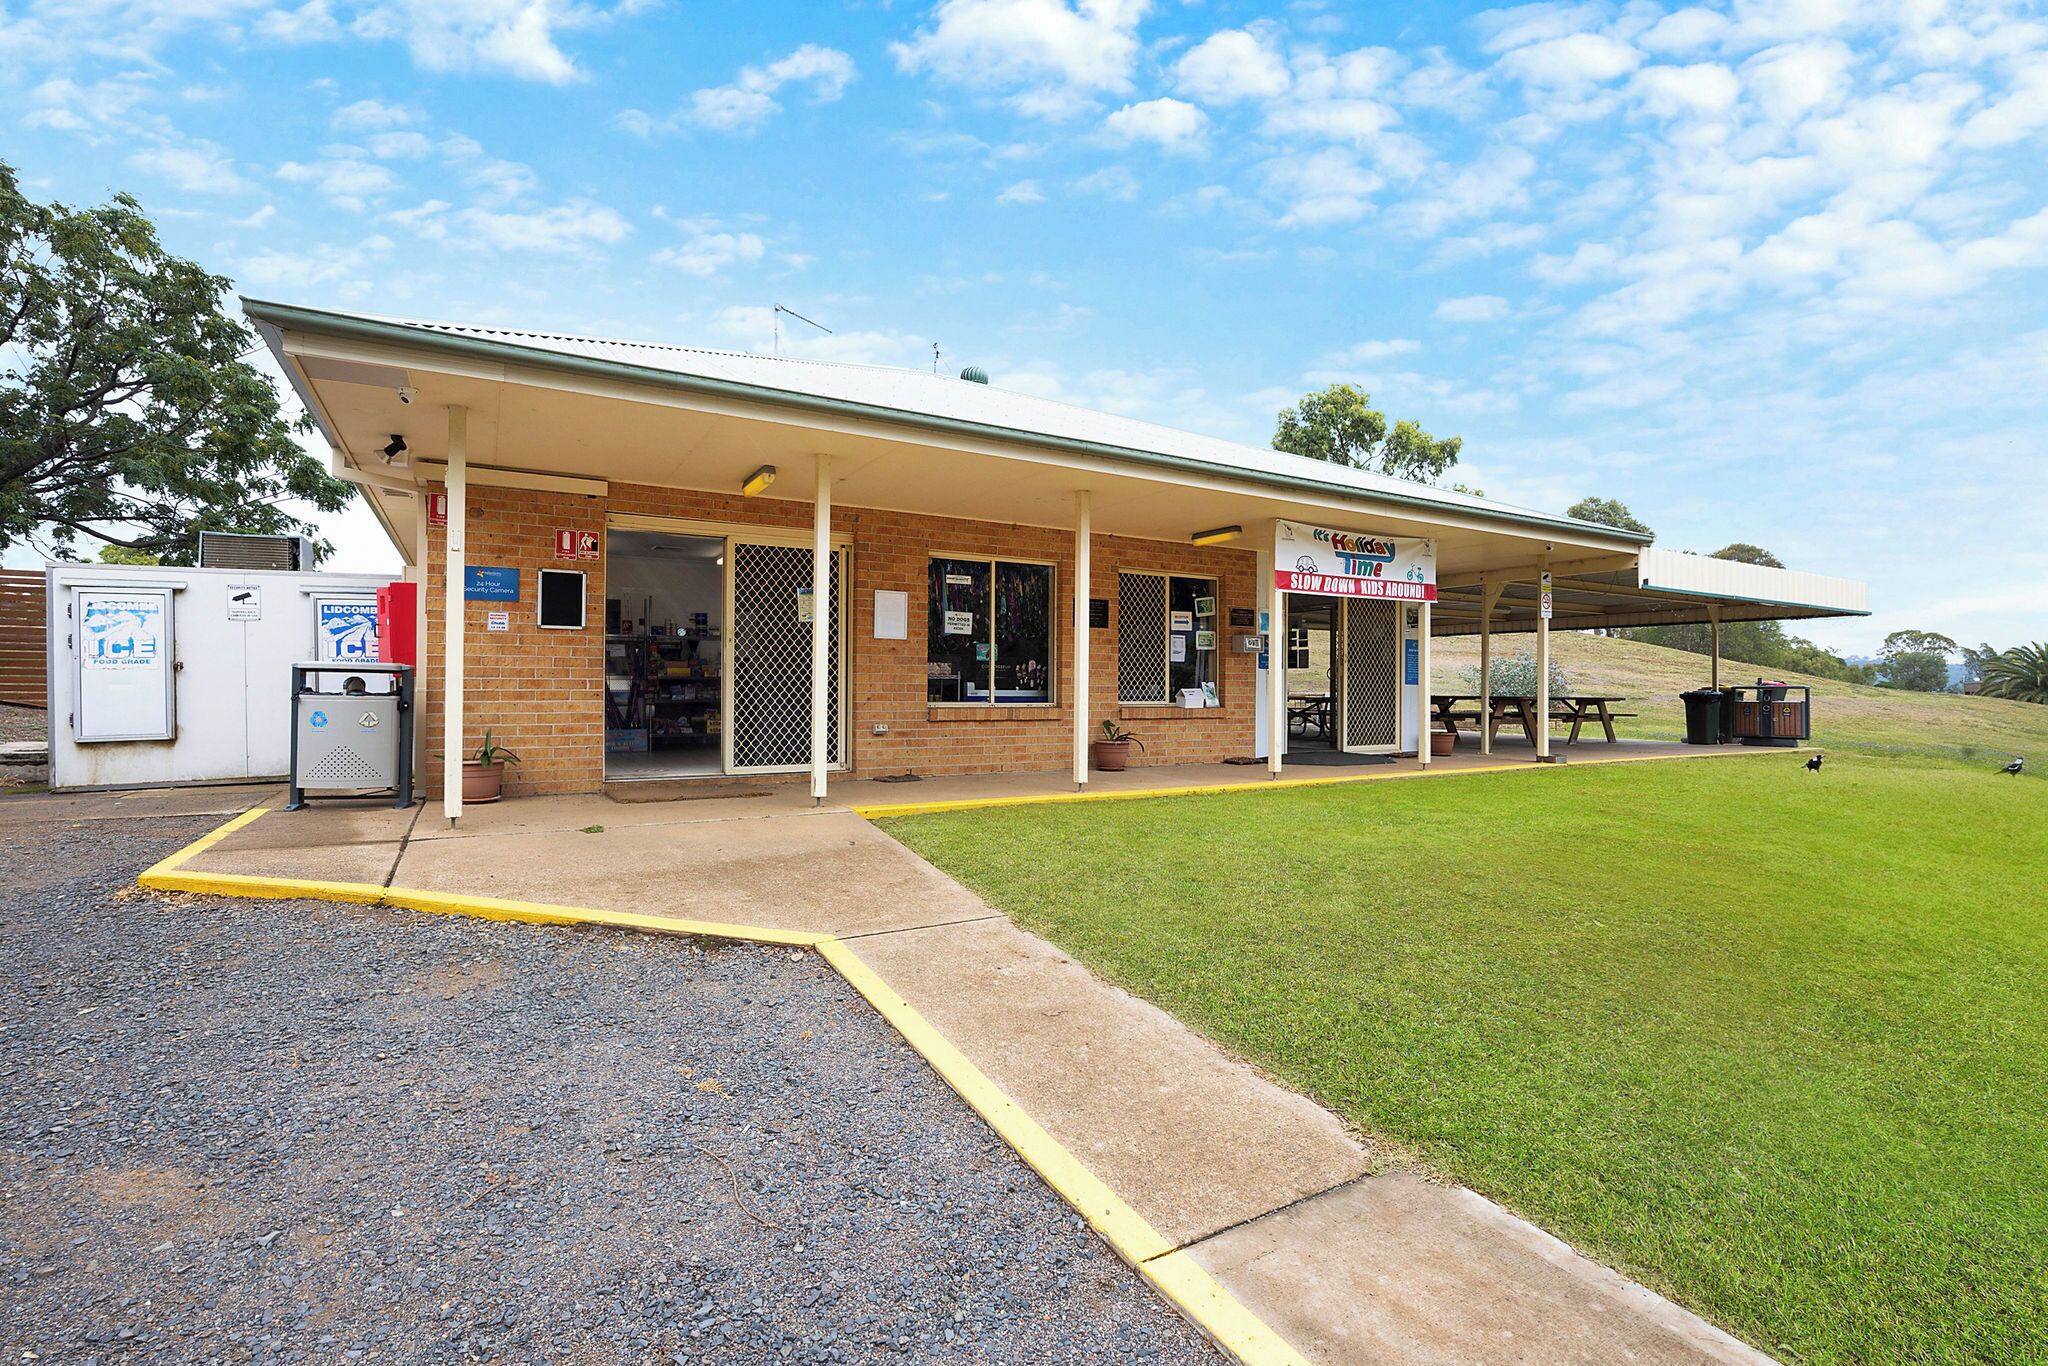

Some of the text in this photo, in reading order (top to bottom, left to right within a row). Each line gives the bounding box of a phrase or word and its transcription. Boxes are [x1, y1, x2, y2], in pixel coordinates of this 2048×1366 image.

[1313, 528, 1396, 562] It's Holiday
[1336, 552, 1383, 577] Time
[1290, 573, 1425, 599] SLOW DOWN KIDS AROUND!
[323, 605, 377, 614] LIDCOMB
[87, 637, 156, 659] ICE
[328, 640, 378, 659] ICE
